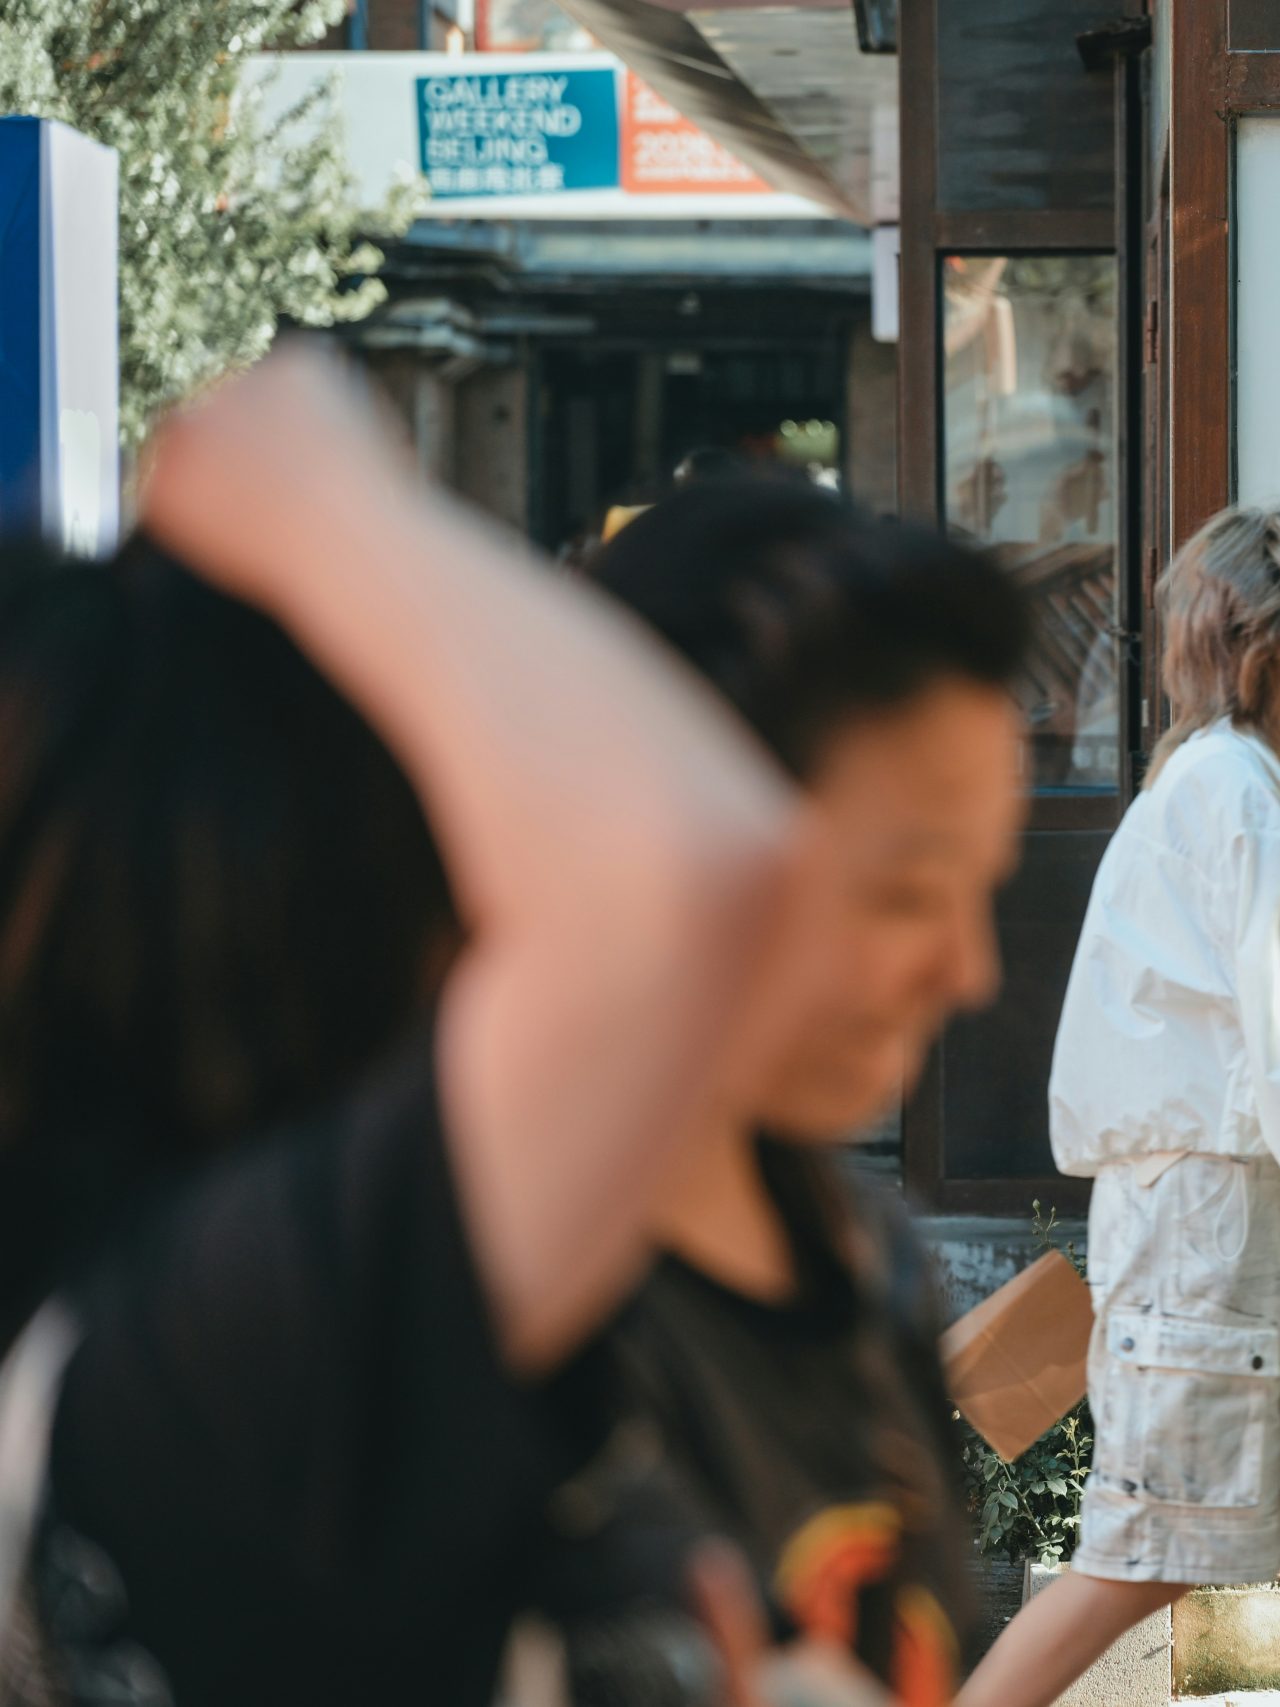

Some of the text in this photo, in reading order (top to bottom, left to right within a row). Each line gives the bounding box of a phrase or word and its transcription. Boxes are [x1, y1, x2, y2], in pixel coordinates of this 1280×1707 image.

[424, 76, 568, 104] GALLERY
[425, 105, 581, 136] WEEKEND
[426, 135, 548, 165] BEIJING
